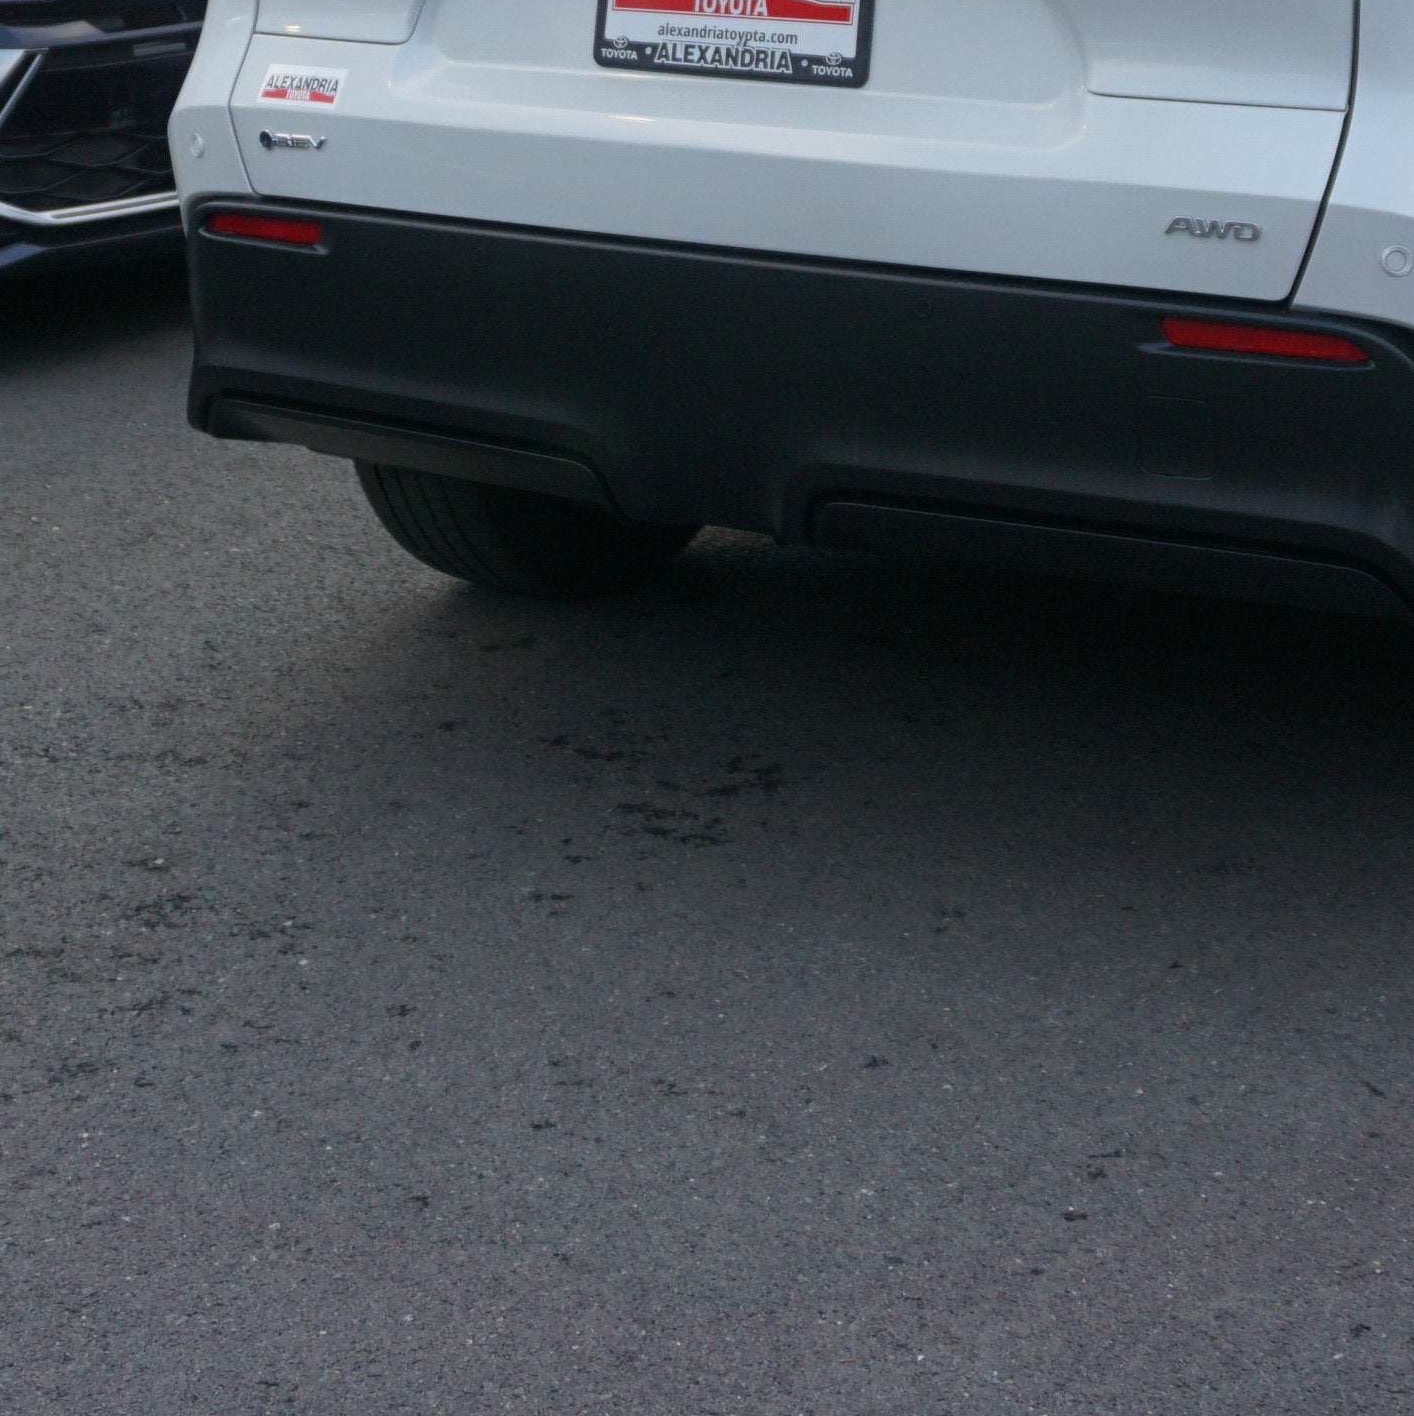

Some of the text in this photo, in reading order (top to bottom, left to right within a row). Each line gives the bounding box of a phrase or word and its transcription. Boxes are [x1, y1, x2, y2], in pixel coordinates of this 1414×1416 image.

[657, 22, 798, 45] alexandriatoyota.com
[600, 48, 638, 60] TOYOTA
[655, 42, 793, 73] ALEXANDRIA
[812, 65, 853, 78] TOYOTA
[265, 74, 339, 94] ALEXANDRIA
[285, 89, 311, 101] TOYOTA
[1164, 215, 1263, 242] AWD
